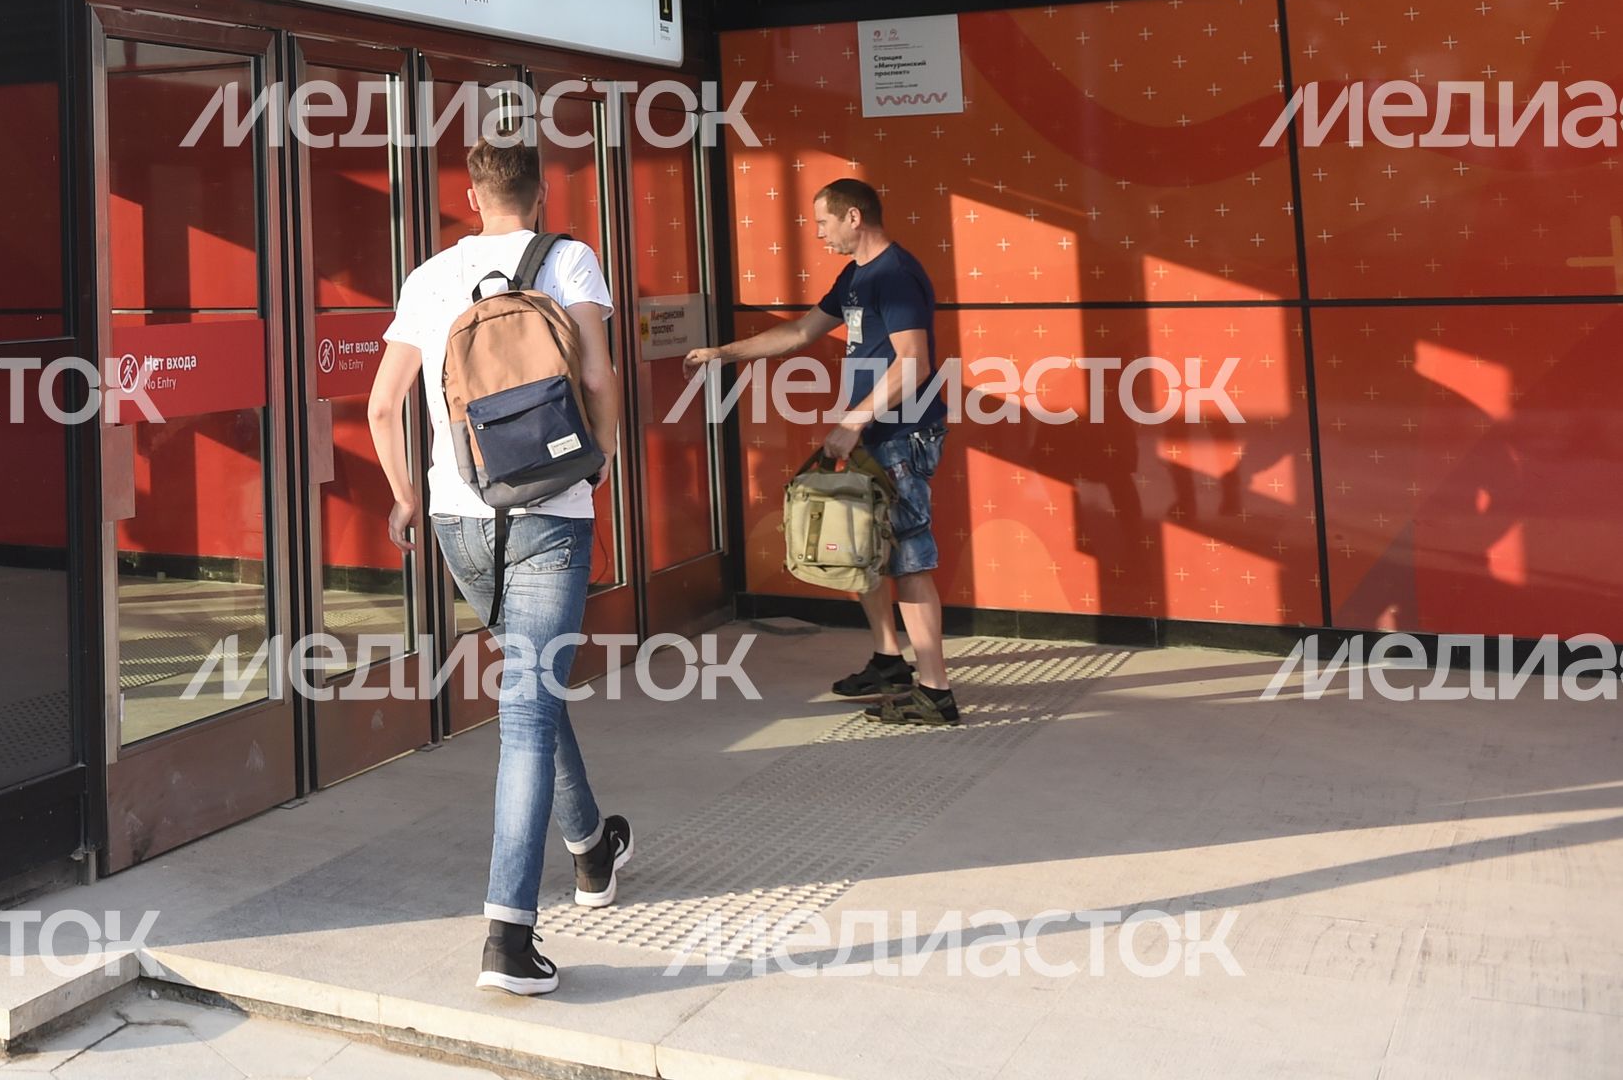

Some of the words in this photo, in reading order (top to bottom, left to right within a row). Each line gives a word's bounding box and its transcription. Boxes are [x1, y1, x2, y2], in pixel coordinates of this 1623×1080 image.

[338, 339, 354, 354] Нет
[355, 341, 379, 354] входа
[144, 354, 164, 372] Нет
[166, 355, 197, 371] входа
[338, 359, 348, 371] No
[348, 359, 364, 371] Entry
[144, 377, 156, 390] No
[157, 376, 177, 390] Entry
